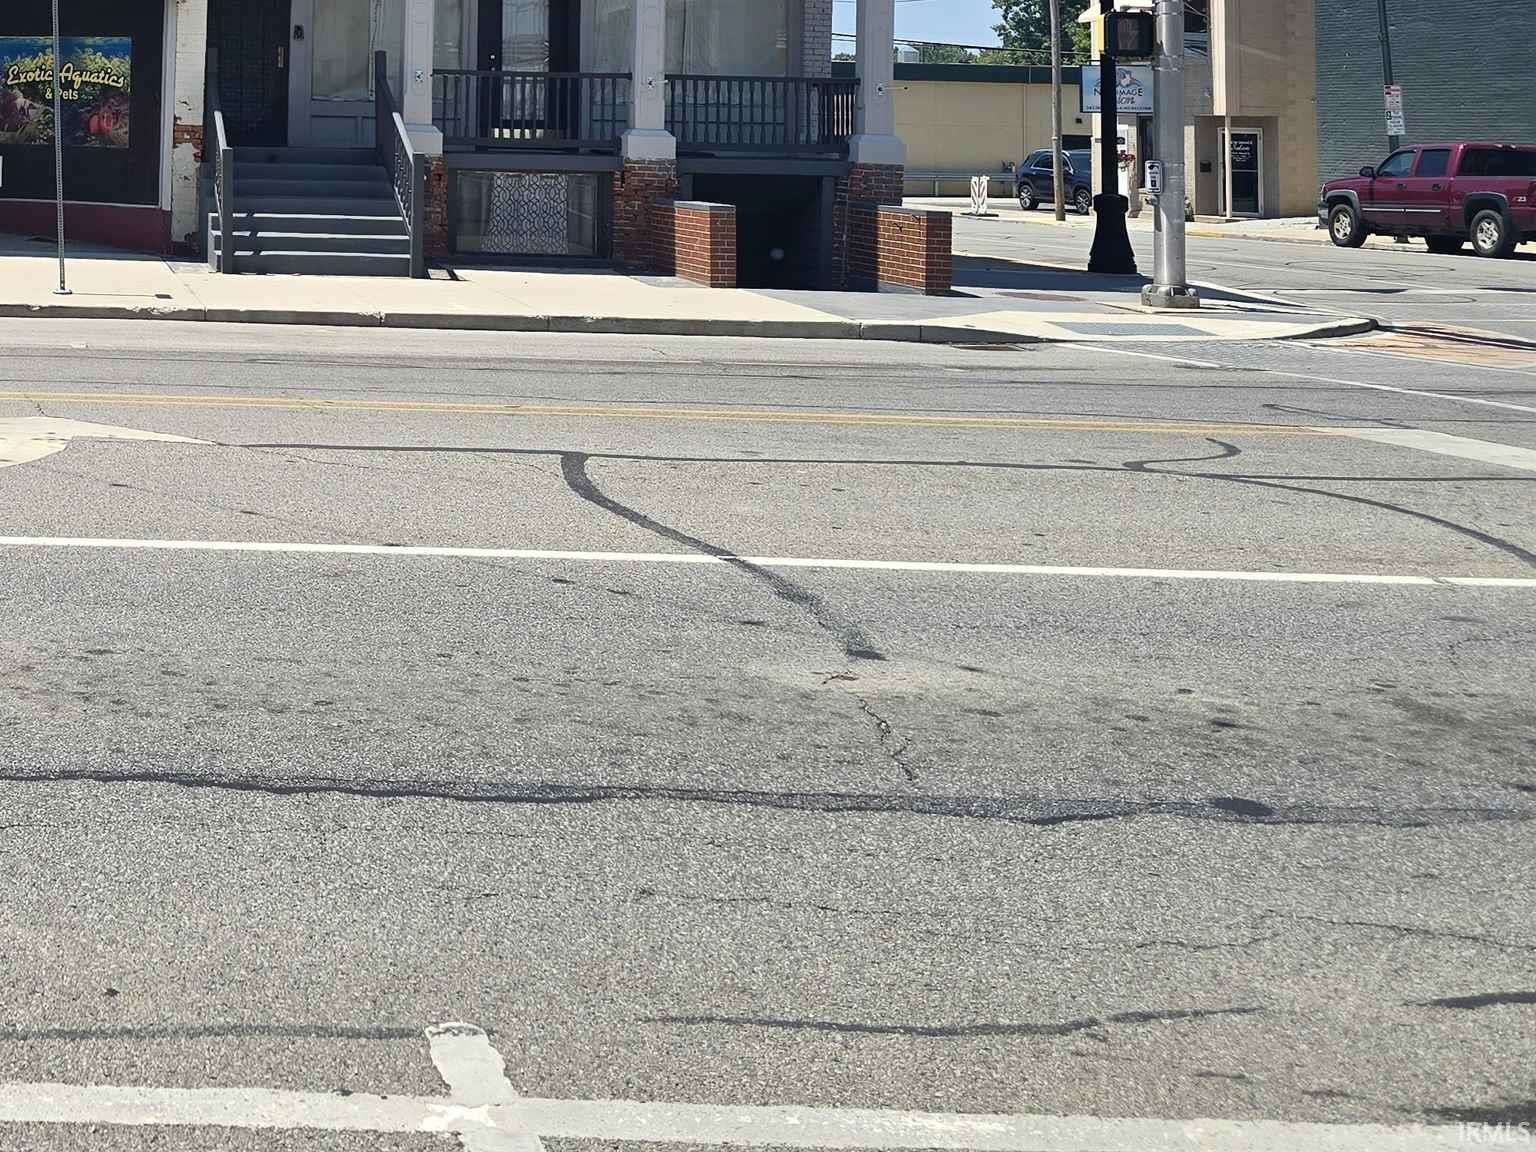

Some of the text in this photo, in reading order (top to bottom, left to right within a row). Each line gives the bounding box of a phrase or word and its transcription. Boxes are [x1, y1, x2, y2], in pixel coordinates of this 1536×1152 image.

[7, 63, 125, 89] Exotic Aquatics
[45, 88, 53, 100] &
[1117, 88, 1143, 97] MAGE
